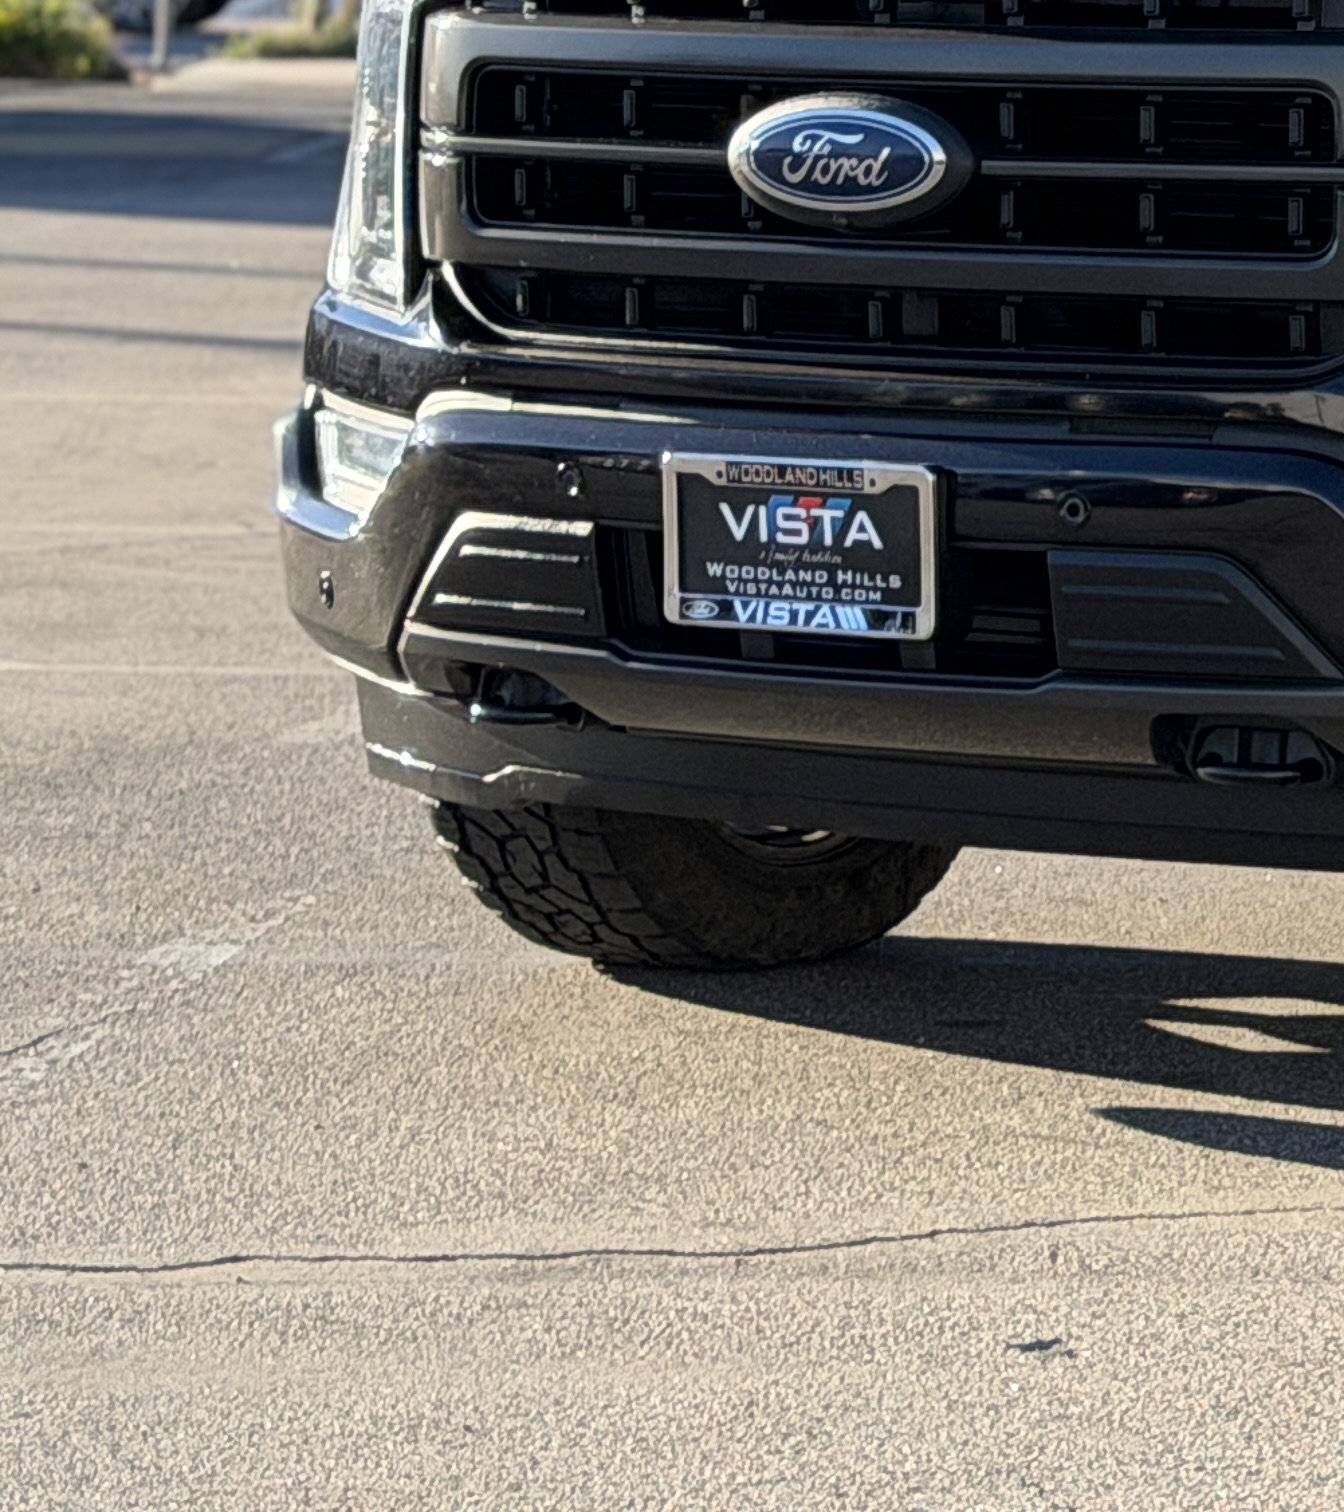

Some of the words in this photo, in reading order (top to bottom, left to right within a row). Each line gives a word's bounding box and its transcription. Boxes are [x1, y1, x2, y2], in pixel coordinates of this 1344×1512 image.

[781, 129, 892, 187] Ford
[718, 501, 884, 550] VISTA
[705, 561, 828, 584] WOODLAND
[836, 569, 902, 589] HILLS
[732, 599, 836, 629] VISTA
